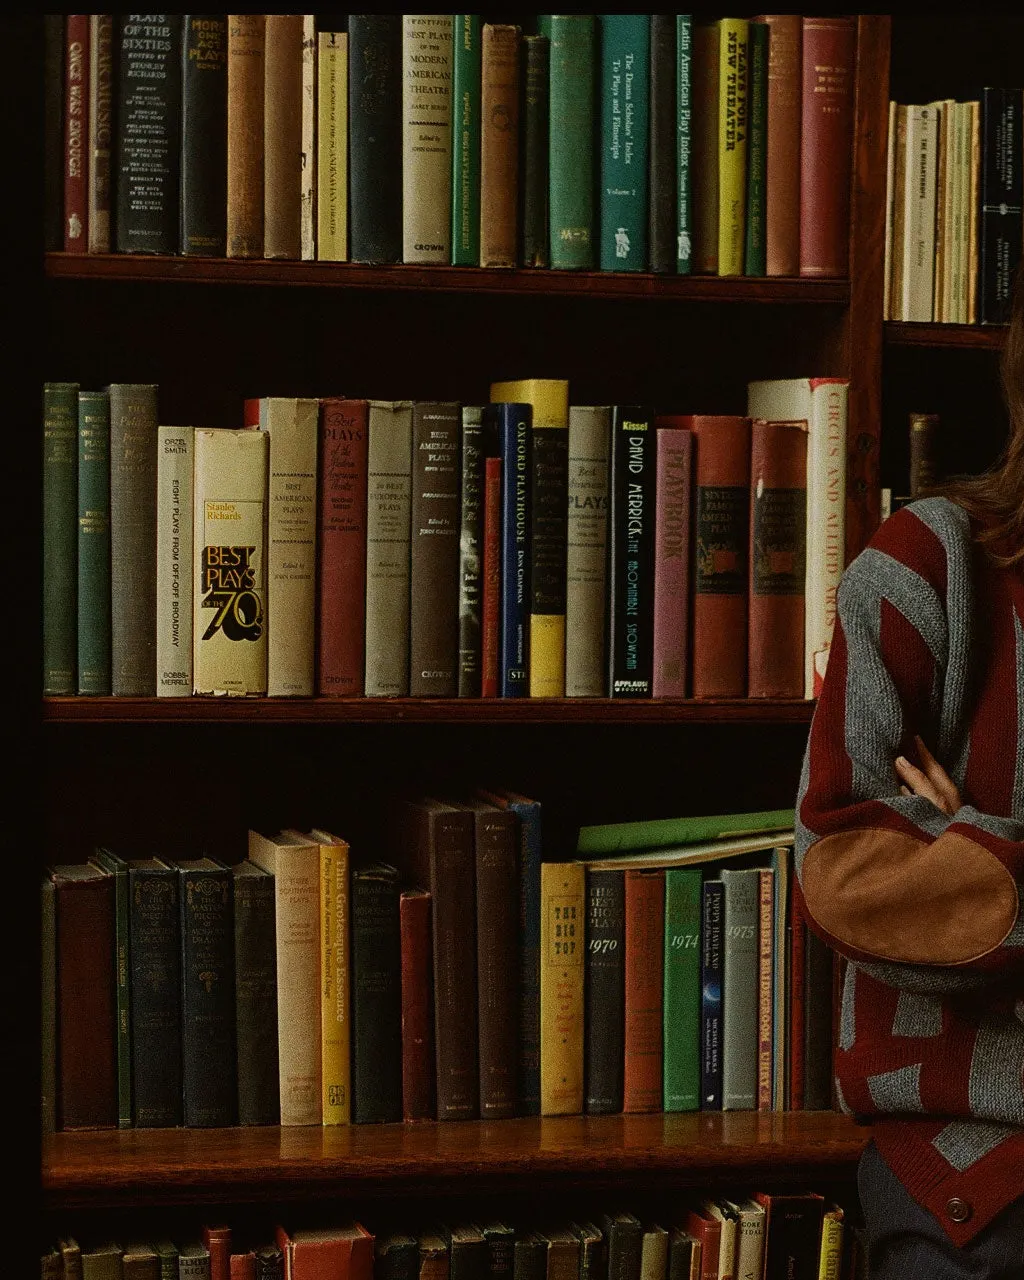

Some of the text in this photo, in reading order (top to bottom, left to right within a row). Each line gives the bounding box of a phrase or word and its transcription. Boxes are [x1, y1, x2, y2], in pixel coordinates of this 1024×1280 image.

[124, 26, 172, 37] OF THE
[122, 40, 172, 51] SIXTIES
[411, 56, 448, 64] MODERN
[406, 71, 451, 80] AMERICAN
[410, 86, 449, 94] THEATRE
[611, 60, 621, 114] To Plays and
[680, 22, 691, 166] Latin American Play Index
[726, 32, 738, 151] NEW THEATER
[736, 43, 746, 142] PLAYS FOR A
[70, 42, 82, 178] ONCE WAS ENOUGH
[98, 81, 112, 141] MUSIC
[625, 54, 634, 164] The Drama Scholars' Index
[622, 421, 648, 431] Kissel
[324, 430, 362, 440] PLAYS
[517, 422, 526, 543] OXFORD PLAYHOUSE
[826, 392, 840, 574] CIRCUS AND ALLIED
[206, 504, 236, 512] Stanley
[568, 495, 608, 508] PLAYS
[664, 447, 684, 560] PLAYBOOK
[207, 512, 242, 520] Richards
[208, 546, 250, 566] BEST
[626, 436, 644, 670] DAVID THE ABOMINABLE SHOWMAN
[206, 568, 254, 589] PLAYS
[554, 908, 576, 918] THE
[712, 892, 720, 922] POPPY
[555, 926, 576, 936] BIG
[728, 926, 754, 938] 1975
[336, 858, 347, 1022] This Grotesque Essence
[554, 943, 576, 954] TOP
[589, 940, 618, 954] 1970
[672, 935, 699, 950] 1974
[761, 874, 772, 1042] THE ROBBER BRIDEGROOM
